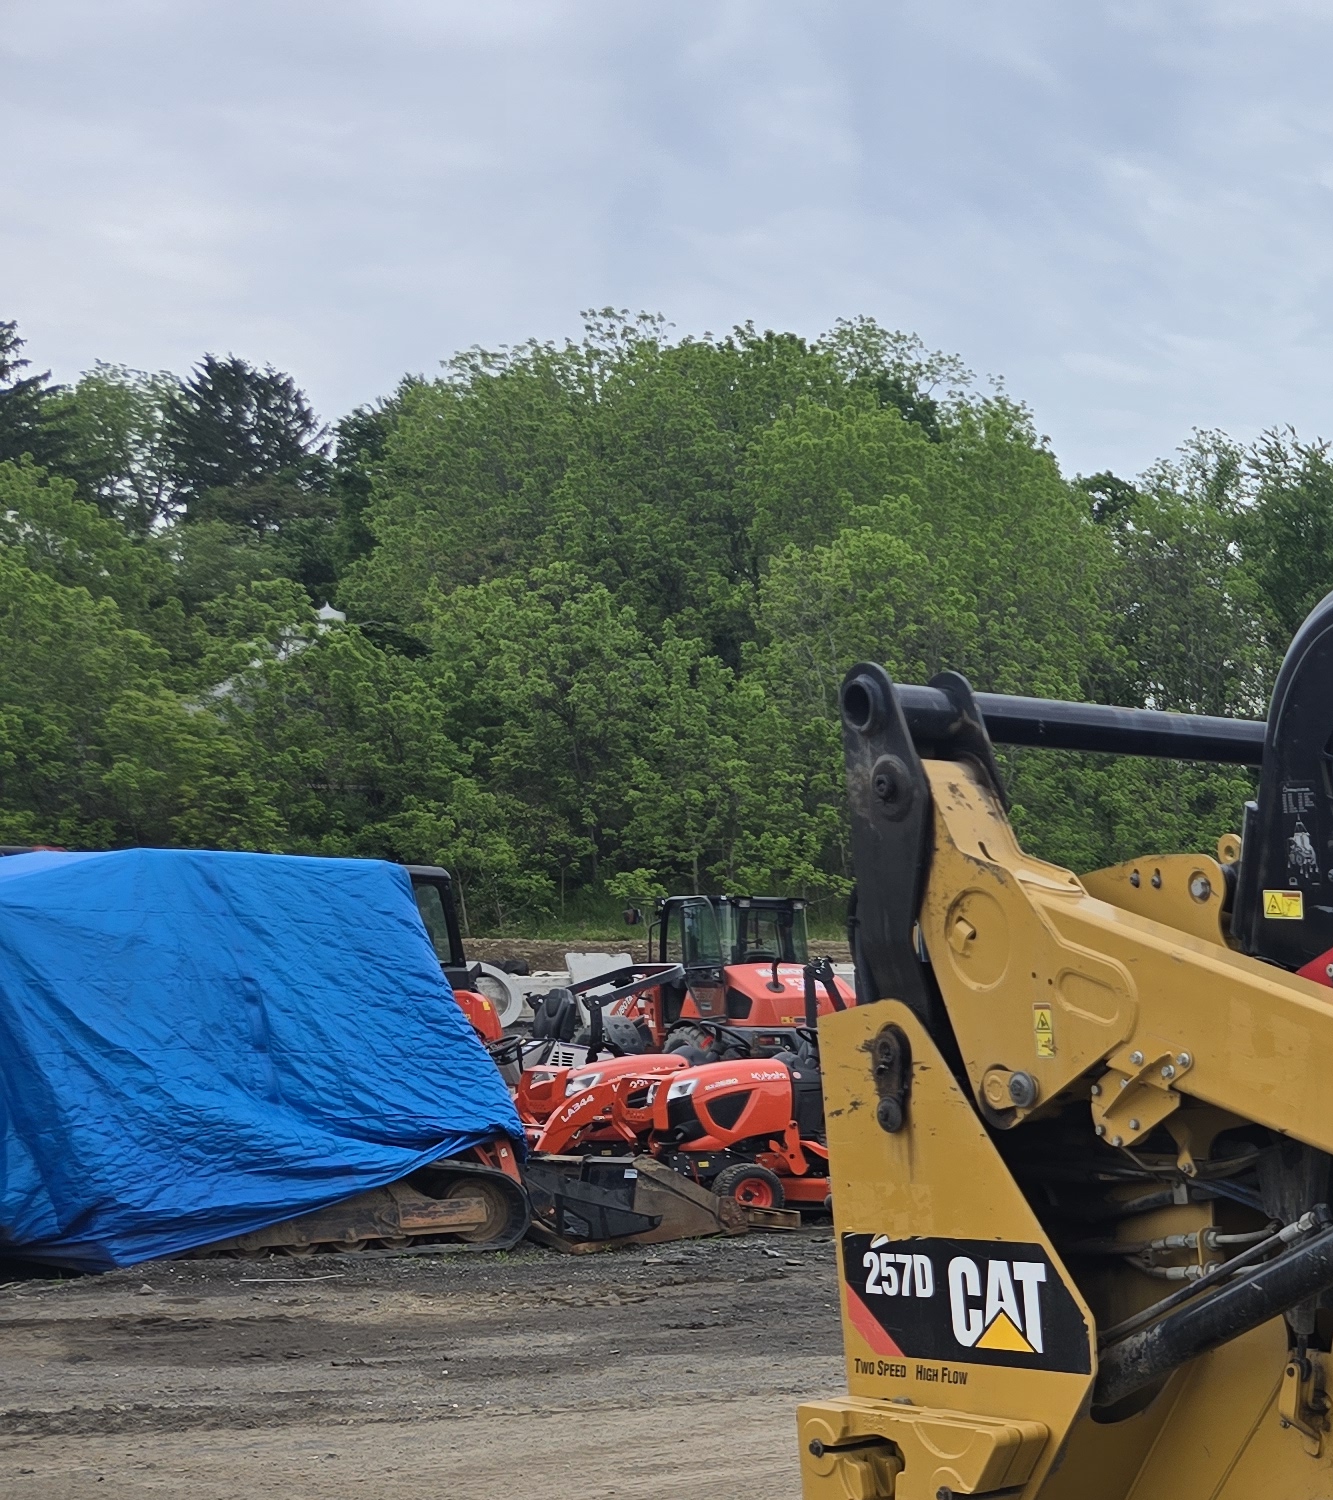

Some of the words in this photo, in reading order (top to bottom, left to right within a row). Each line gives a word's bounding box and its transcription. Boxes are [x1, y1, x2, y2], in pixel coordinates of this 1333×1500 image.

[560, 1094, 595, 1123] LA344
[862, 1251, 935, 1298] 257D
[948, 1256, 1047, 1354] CAT
